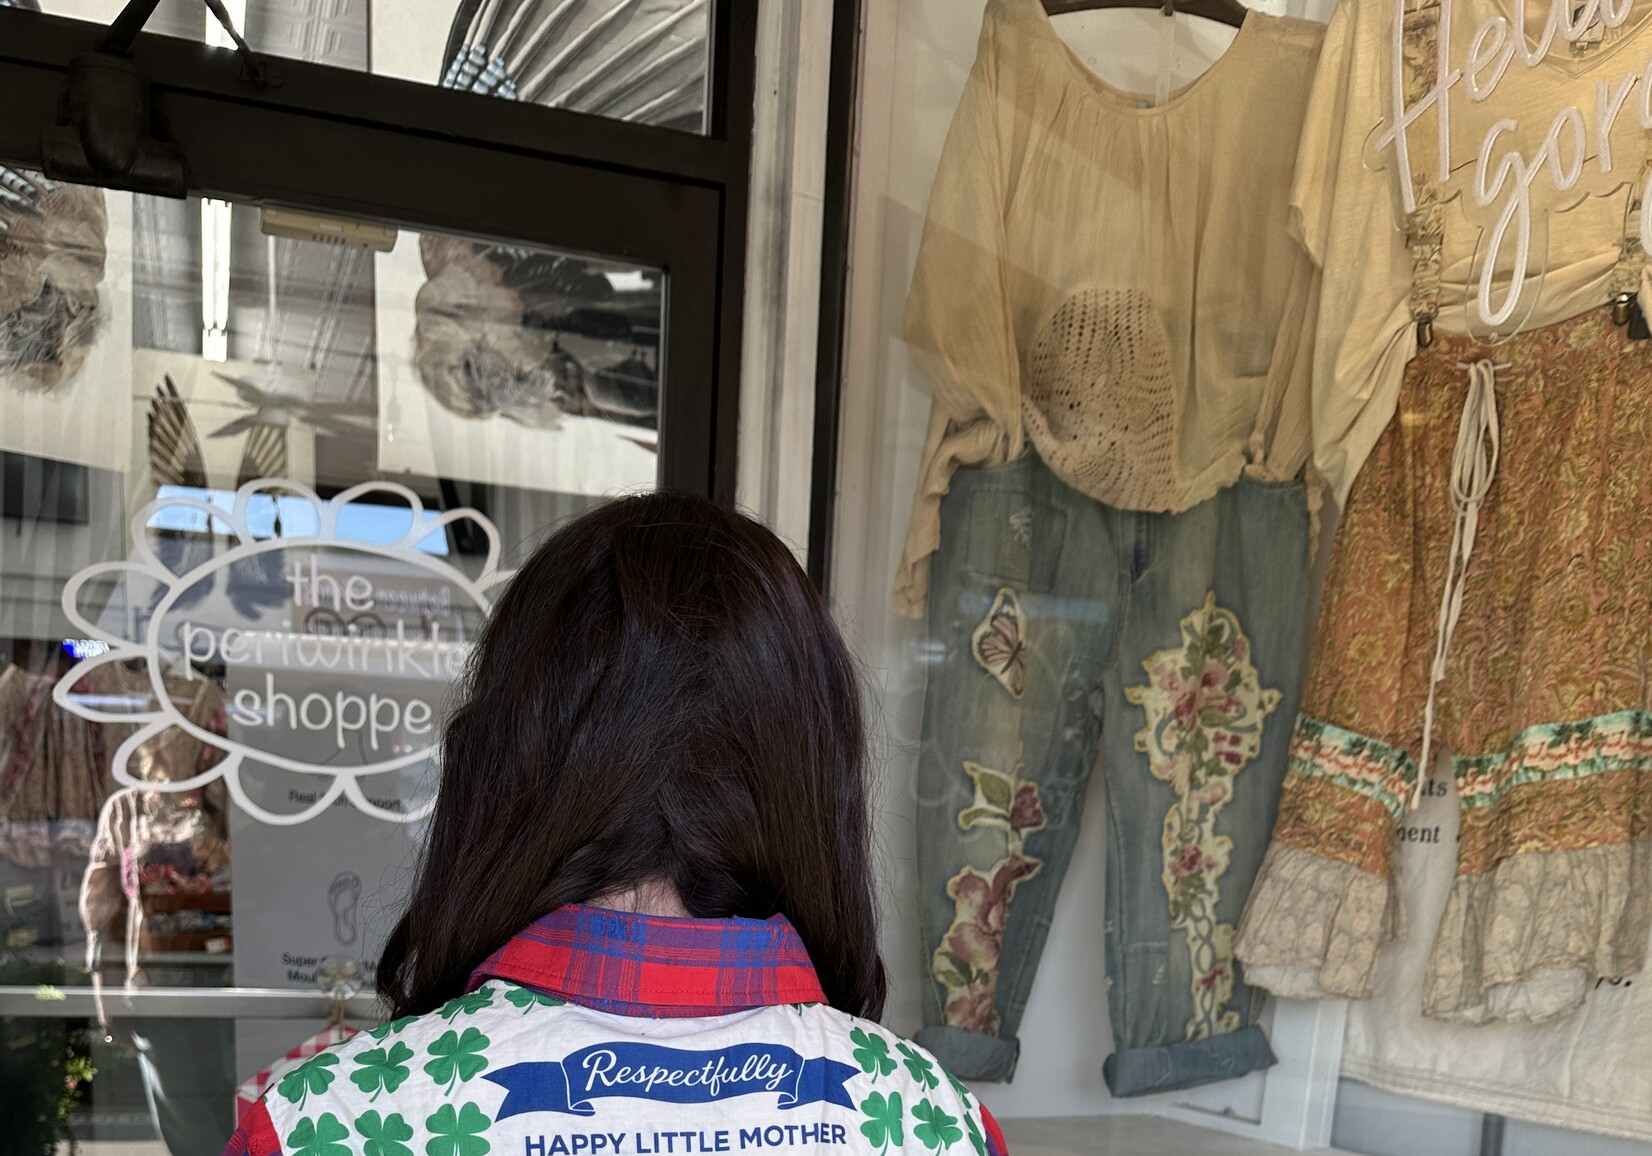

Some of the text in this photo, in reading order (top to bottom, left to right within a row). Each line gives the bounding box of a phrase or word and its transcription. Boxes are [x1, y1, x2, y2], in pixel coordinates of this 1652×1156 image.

[1474, 57, 1652, 326] gor
[287, 554, 375, 611] the
[231, 672, 432, 750] shoppe
[582, 1049, 794, 1096] Respectfully
[636, 1129, 731, 1154] LITTLE
[739, 1122, 847, 1150] MOTHER
